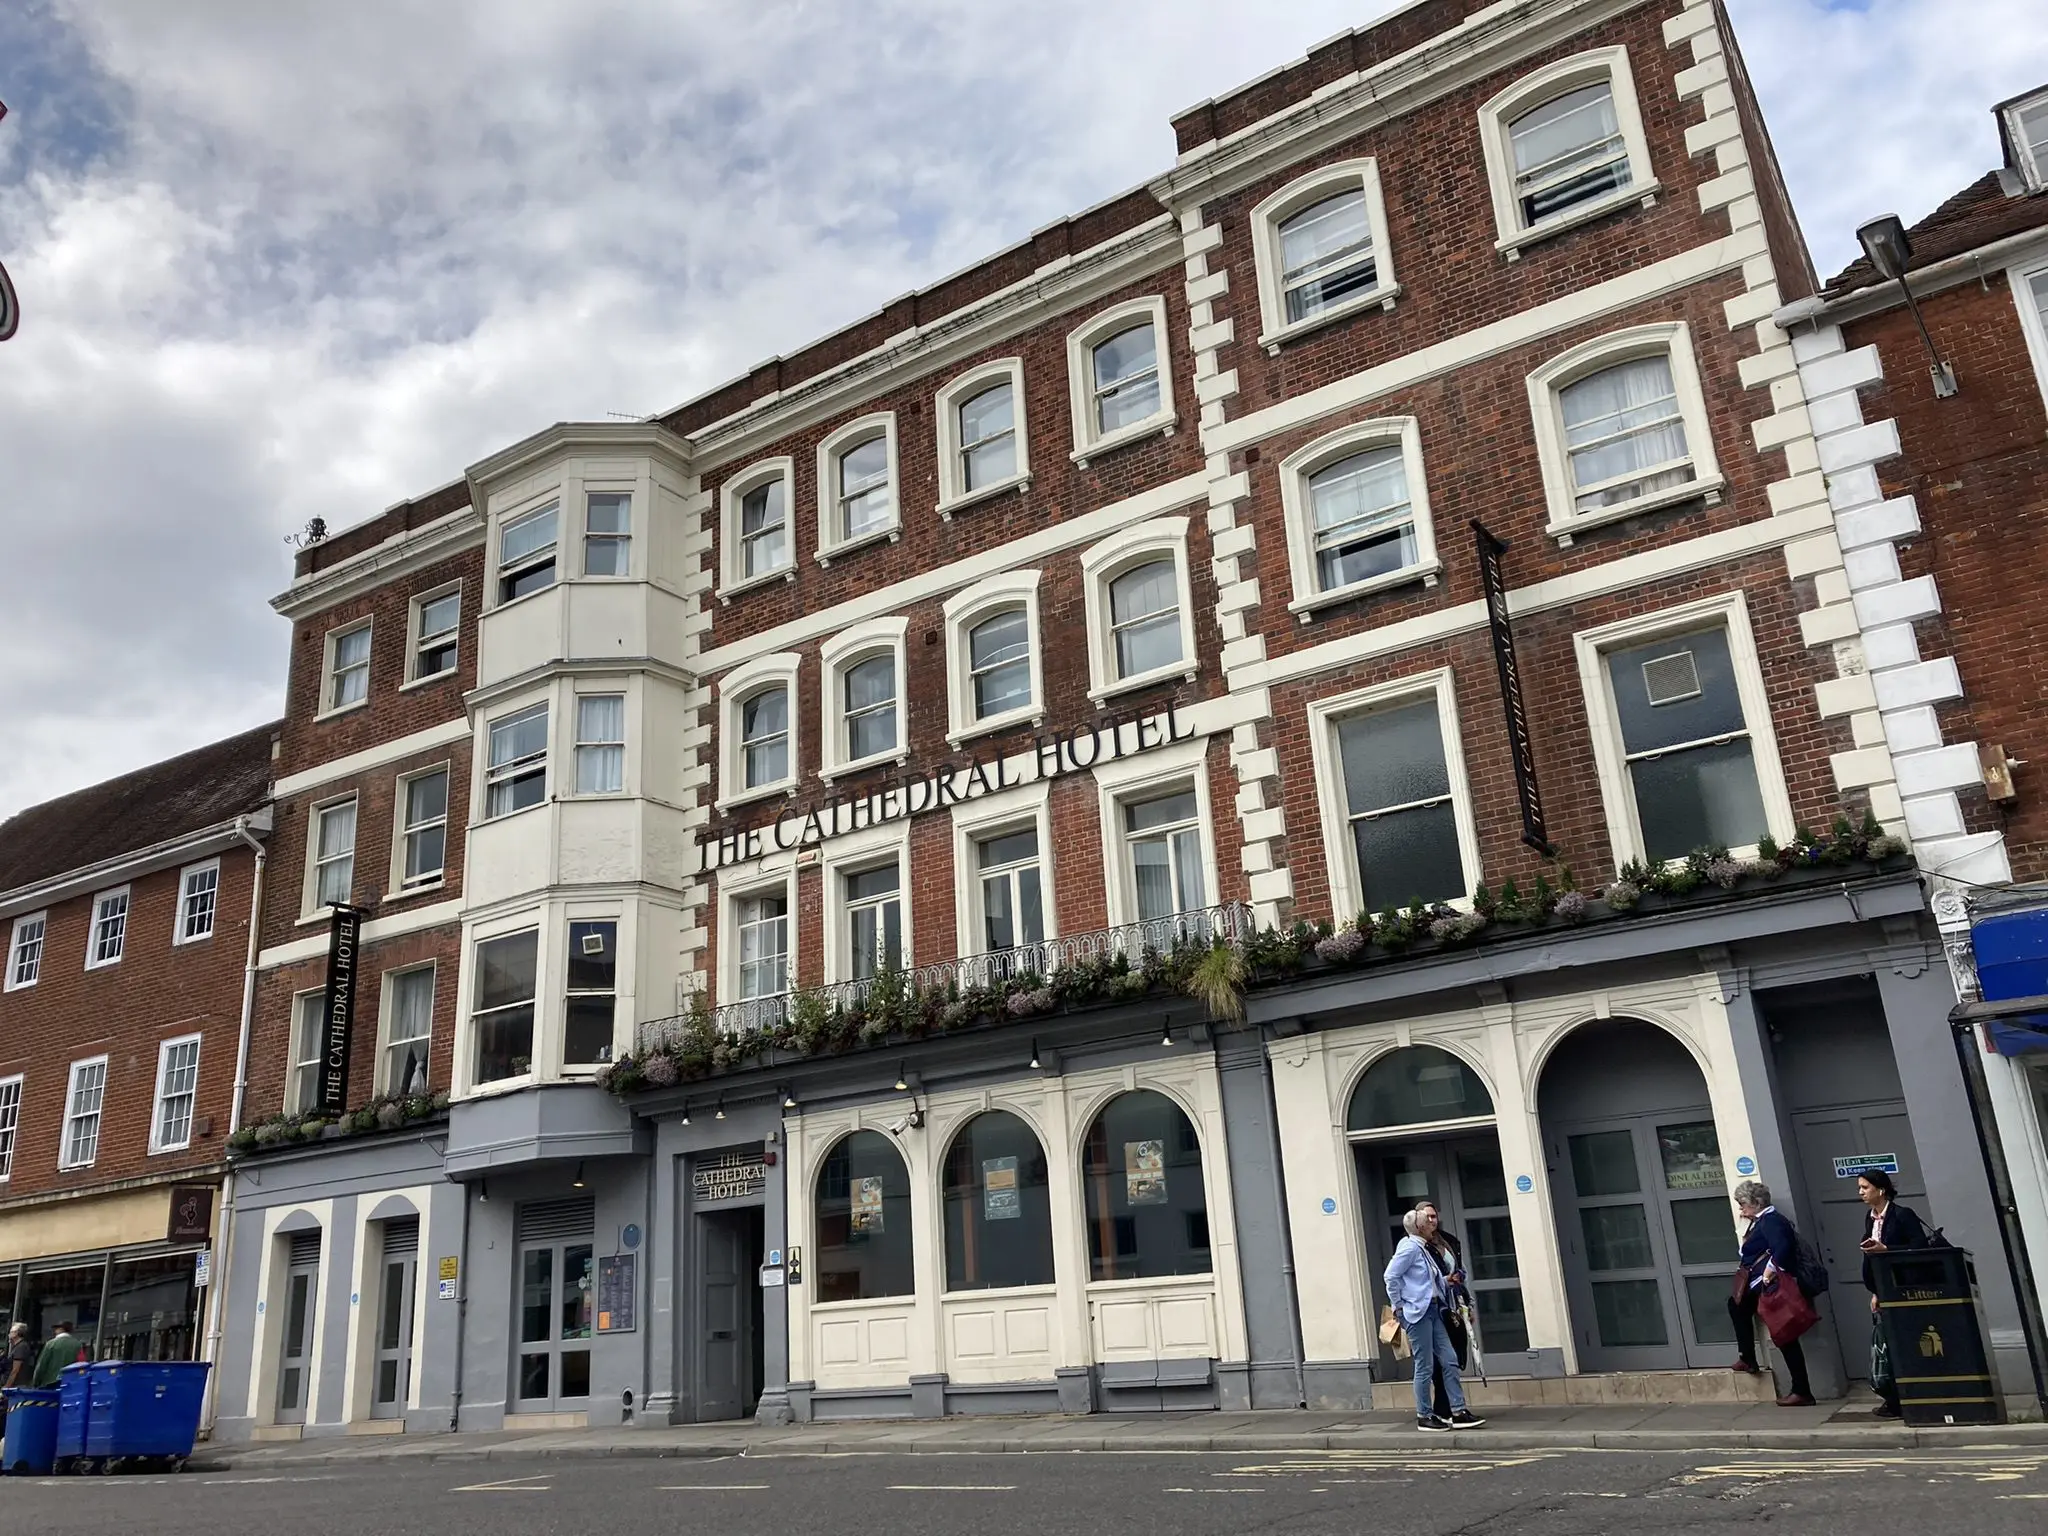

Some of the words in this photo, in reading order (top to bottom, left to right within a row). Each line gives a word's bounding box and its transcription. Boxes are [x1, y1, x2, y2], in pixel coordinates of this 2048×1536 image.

[1487, 552, 1509, 627] HOTEL
[1499, 634, 1534, 773] CATHEDRAL
[696, 821, 763, 872] THE
[774, 750, 1021, 850] CATHEDRAL
[1033, 697, 1197, 780] HOTEL
[1523, 775, 1542, 826] THE
[338, 918, 354, 970] HOTEL
[329, 973, 348, 1068] CATHEDRAL
[326, 1071, 341, 1103] THE
[720, 1152, 744, 1167] THE
[1846, 1158, 1861, 1166] Exit
[709, 1182, 752, 1199] HOTEL
[1906, 1290, 1938, 1300] Litter
